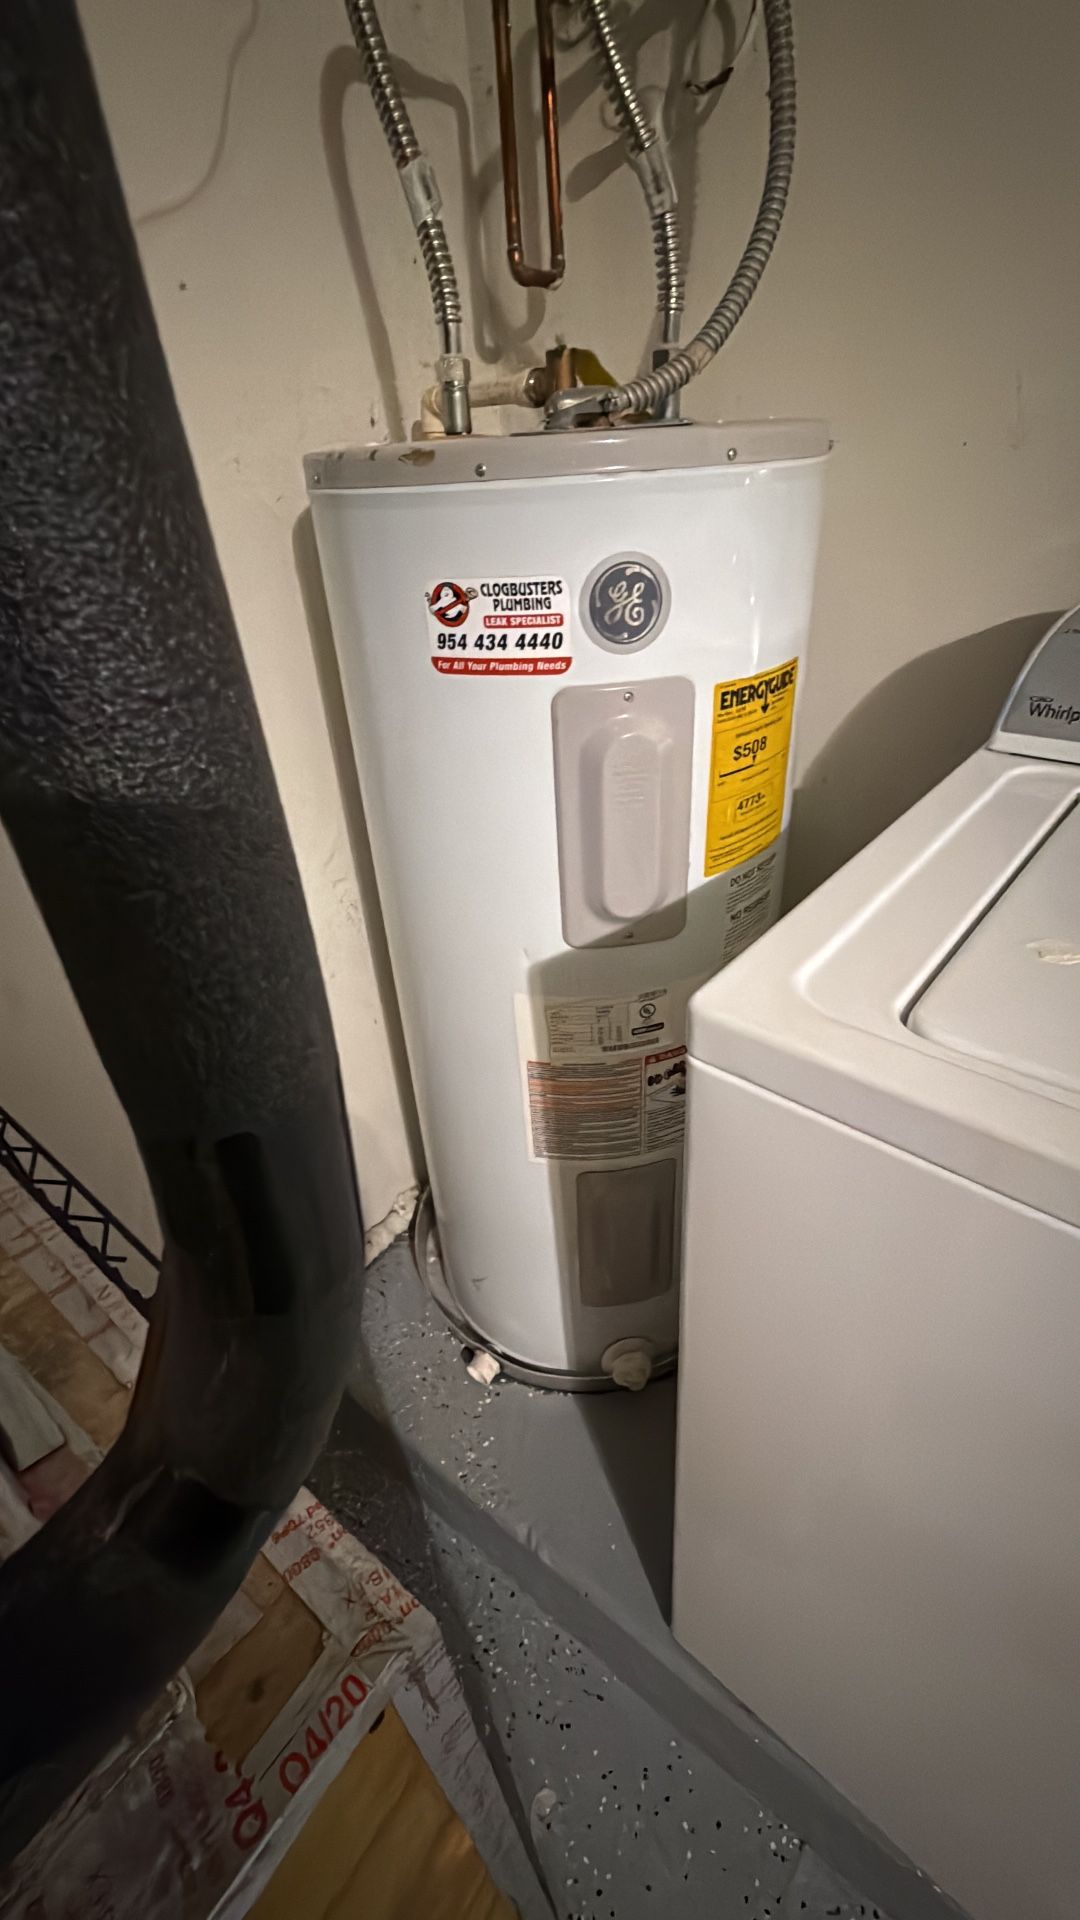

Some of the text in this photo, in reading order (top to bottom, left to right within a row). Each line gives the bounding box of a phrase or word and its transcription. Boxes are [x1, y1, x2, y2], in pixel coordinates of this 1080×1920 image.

[480, 580, 563, 598] CLOGBUSTERS
[493, 597, 552, 612] PLUMBING
[604, 581, 645, 626] GE
[485, 614, 562, 627] LEAK SPECIALIST
[437, 632, 563, 651] 954 434 4440
[437, 660, 567, 672] For All Your Plumbing Needs
